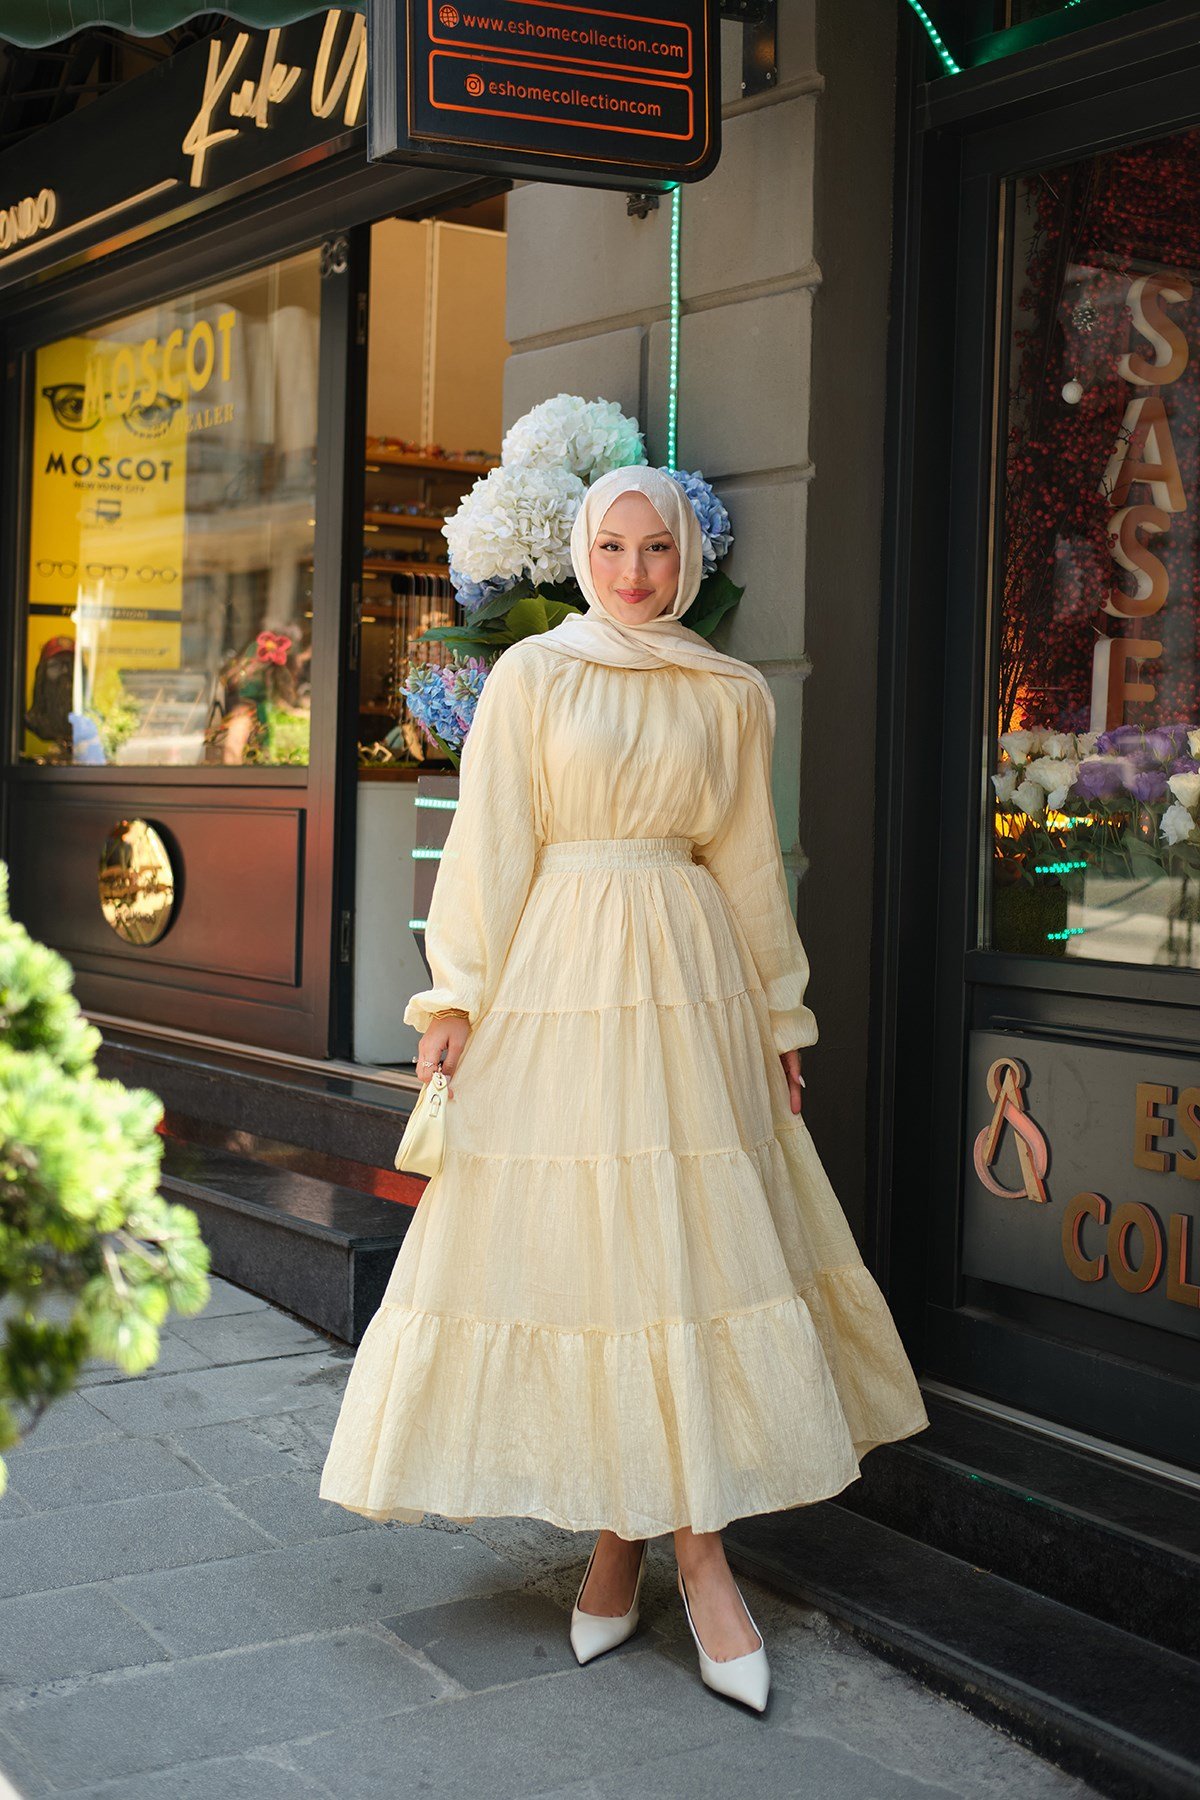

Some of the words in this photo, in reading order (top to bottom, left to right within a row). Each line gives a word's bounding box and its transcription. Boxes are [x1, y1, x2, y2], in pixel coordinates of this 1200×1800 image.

[462, 12, 684, 58] www.eshomecollection.com
[488, 81, 662, 117] eshomecollectioncom
[82, 310, 236, 425] MOSCOT
[45, 451, 172, 483] MOSCOT
[1061, 1191, 1200, 1309] COL
